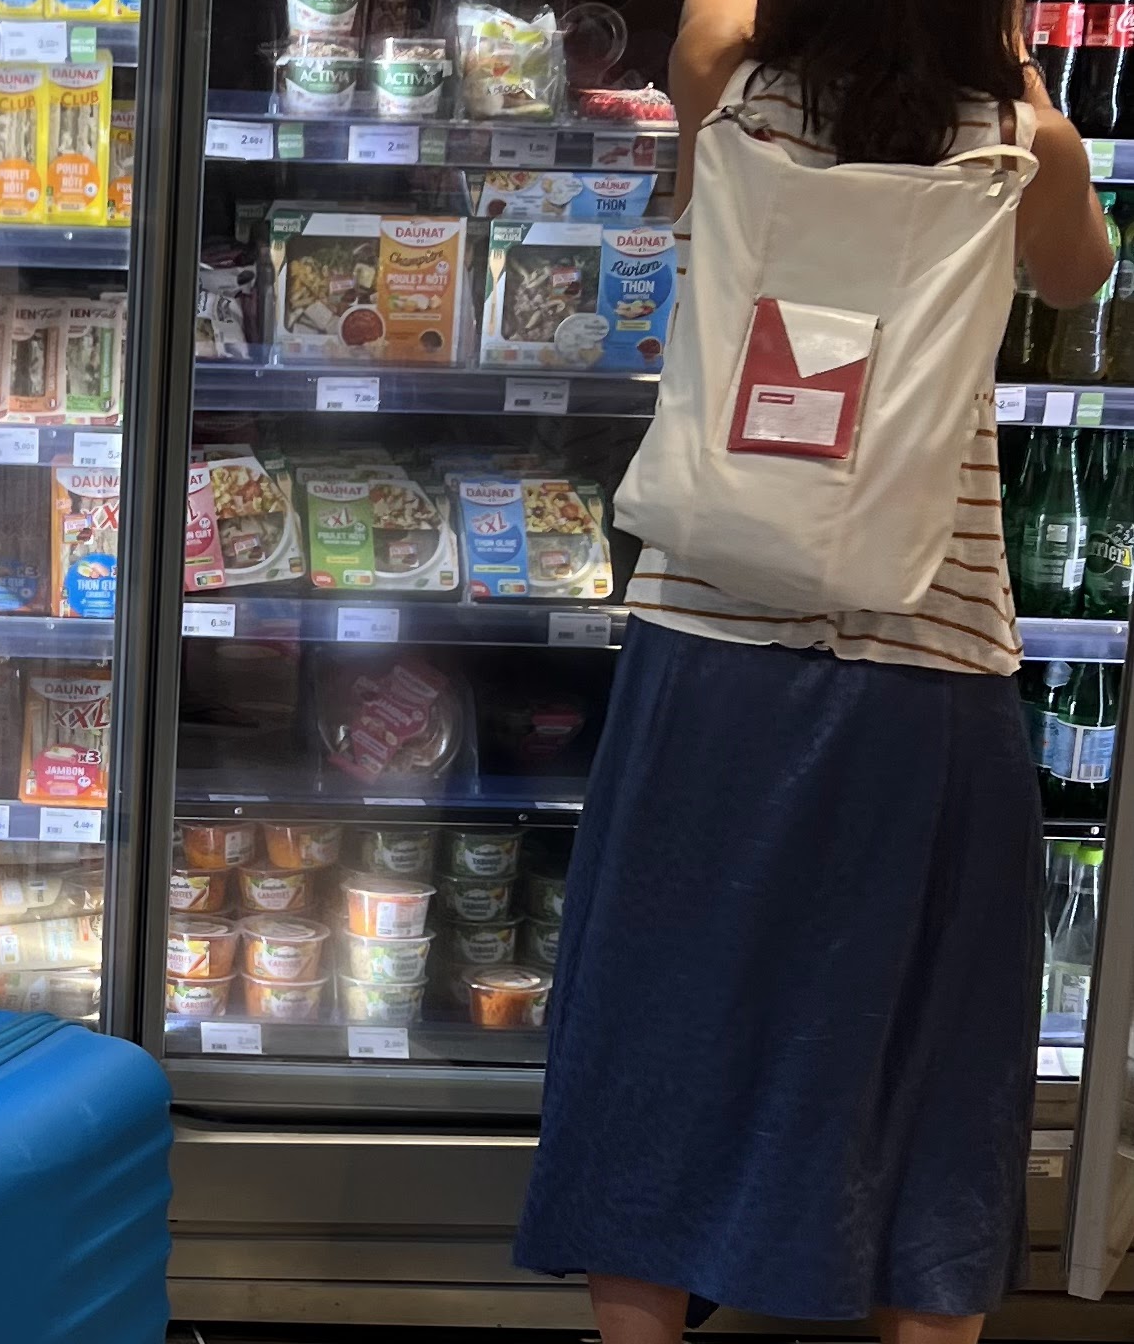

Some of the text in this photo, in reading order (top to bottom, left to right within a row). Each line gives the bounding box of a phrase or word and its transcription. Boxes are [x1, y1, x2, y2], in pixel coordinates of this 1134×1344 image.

[52, 67, 100, 80] DAUNAT
[300, 69, 350, 84] ACTIVIA
[384, 71, 435, 86] ACTIVIA
[60, 90, 99, 106] CLUB
[56, 163, 89, 175] POULET
[594, 180, 630, 191] DAUNAT
[596, 197, 626, 211] THON
[395, 226, 445, 238] DAUNAT
[616, 235, 667, 248] DAUNAT
[611, 260, 663, 279] Riviera
[621, 279, 655, 293] THON
[313, 485, 363, 496] DAUNAT
[467, 488, 515, 498] DAUNAT
[77, 579, 99, 590] THON
[44, 683, 101, 696] DAUNAT
[53, 697, 111, 731] XXL
[45, 765, 85, 776] JAMBON
